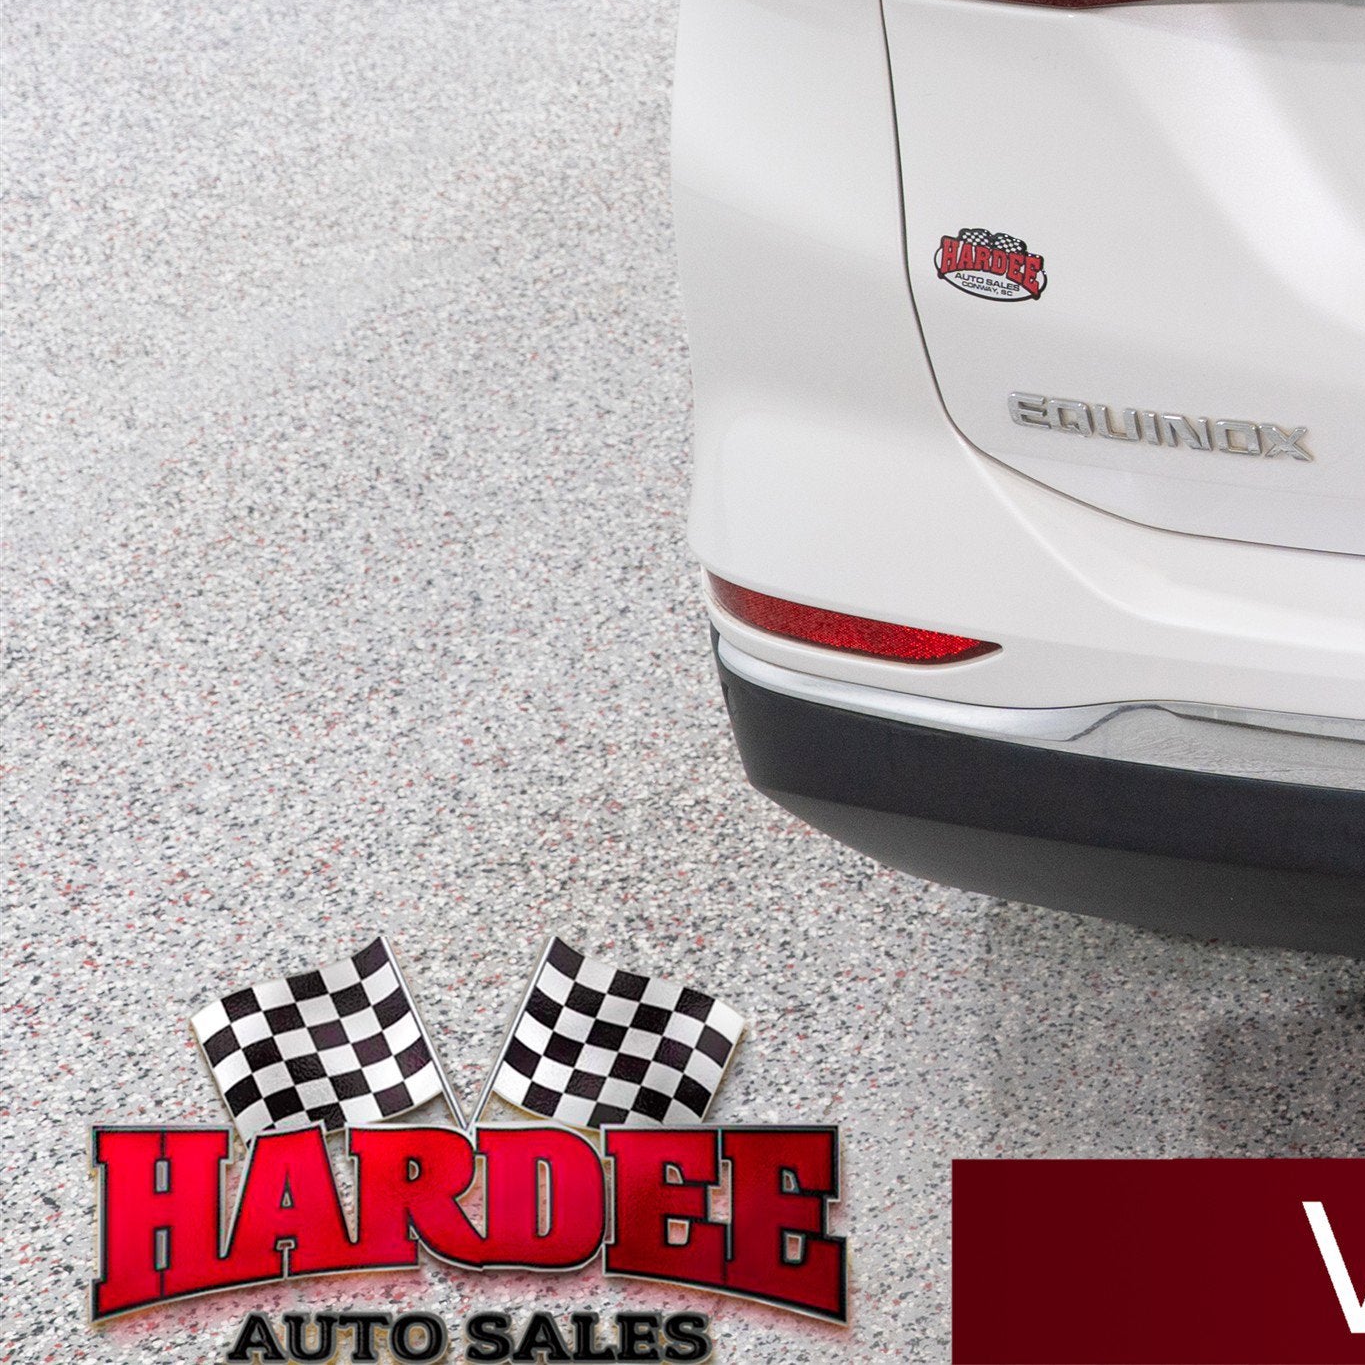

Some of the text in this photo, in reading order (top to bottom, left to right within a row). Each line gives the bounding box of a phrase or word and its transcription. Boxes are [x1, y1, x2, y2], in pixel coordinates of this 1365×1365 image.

[940, 236, 1042, 297] HARDEE
[955, 272, 1020, 292] AUTO SALES
[961, 280, 1014, 297] CONWAY, SC
[1007, 390, 1315, 462] EQUINOX
